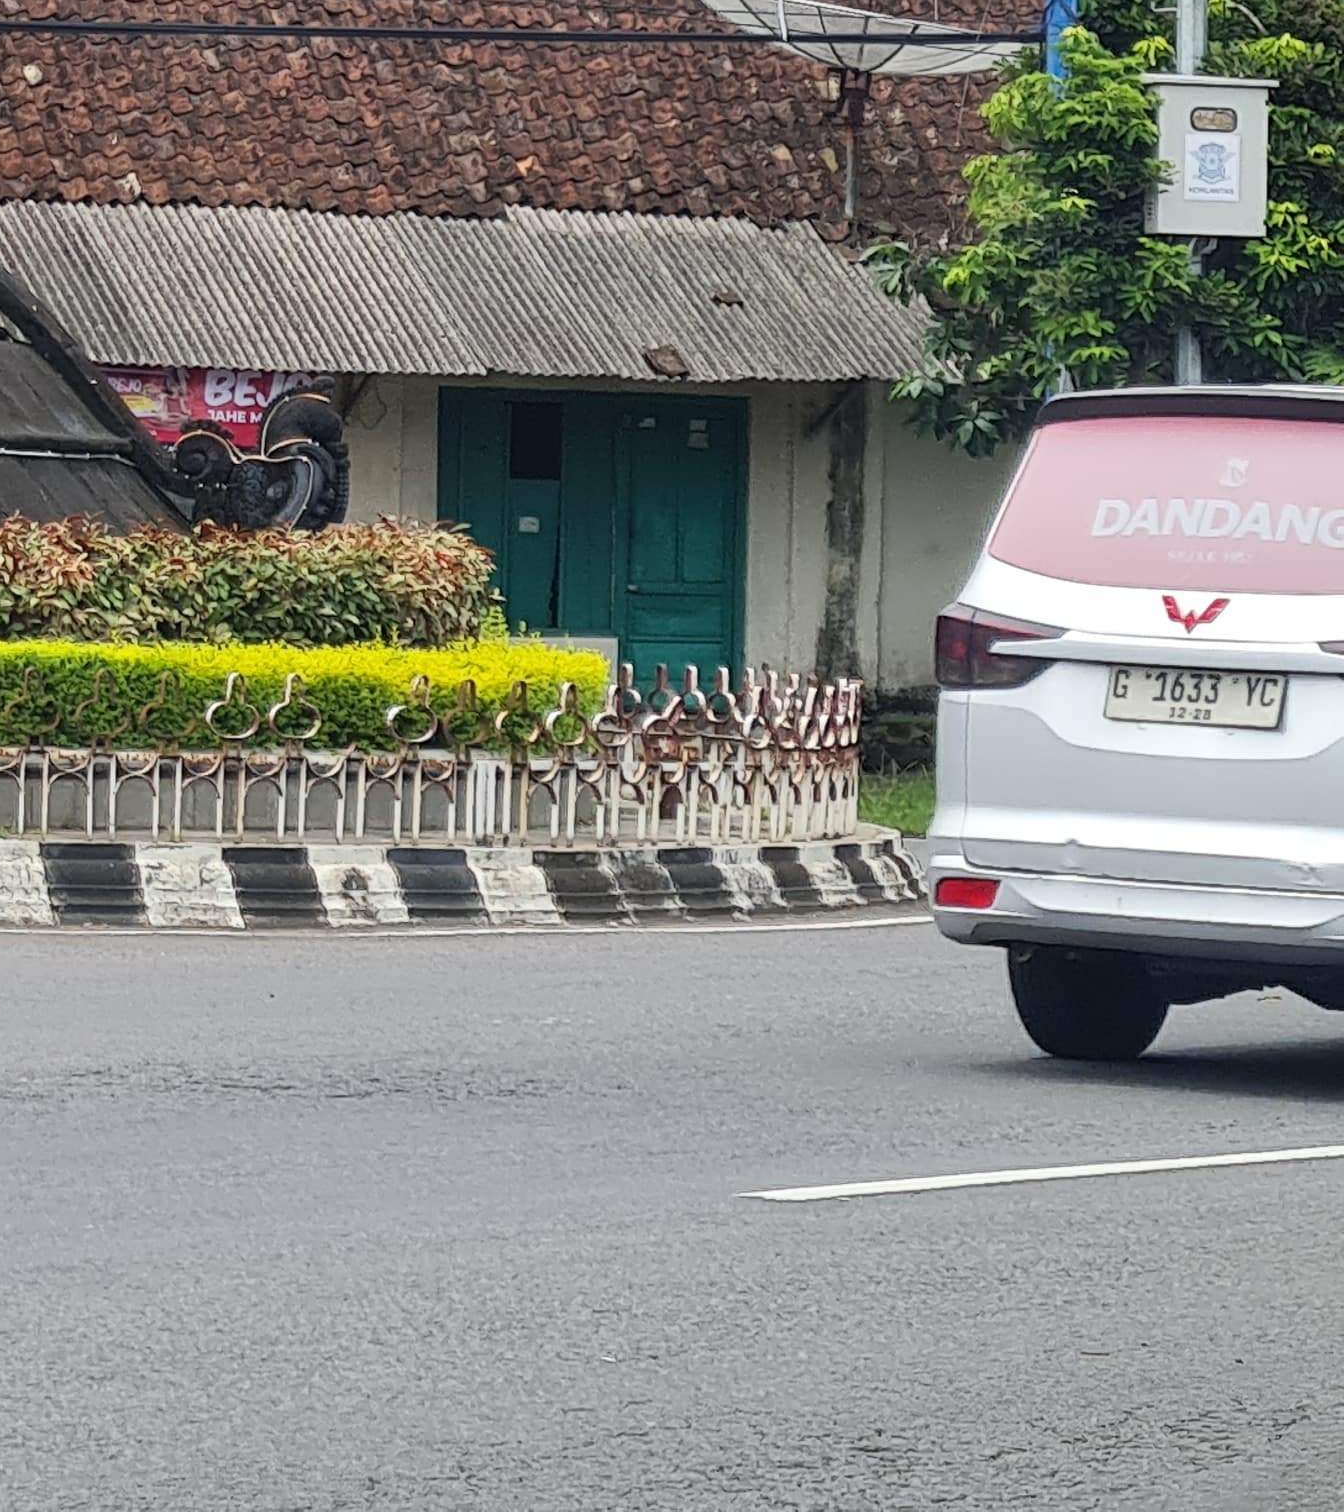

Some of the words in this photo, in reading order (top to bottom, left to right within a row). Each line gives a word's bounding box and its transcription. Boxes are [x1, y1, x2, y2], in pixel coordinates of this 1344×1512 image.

[208, 409, 248, 423] JAHE
[1113, 669, 1131, 699] G
[1152, 671, 1221, 704] 1633
[1246, 675, 1278, 707] YC
